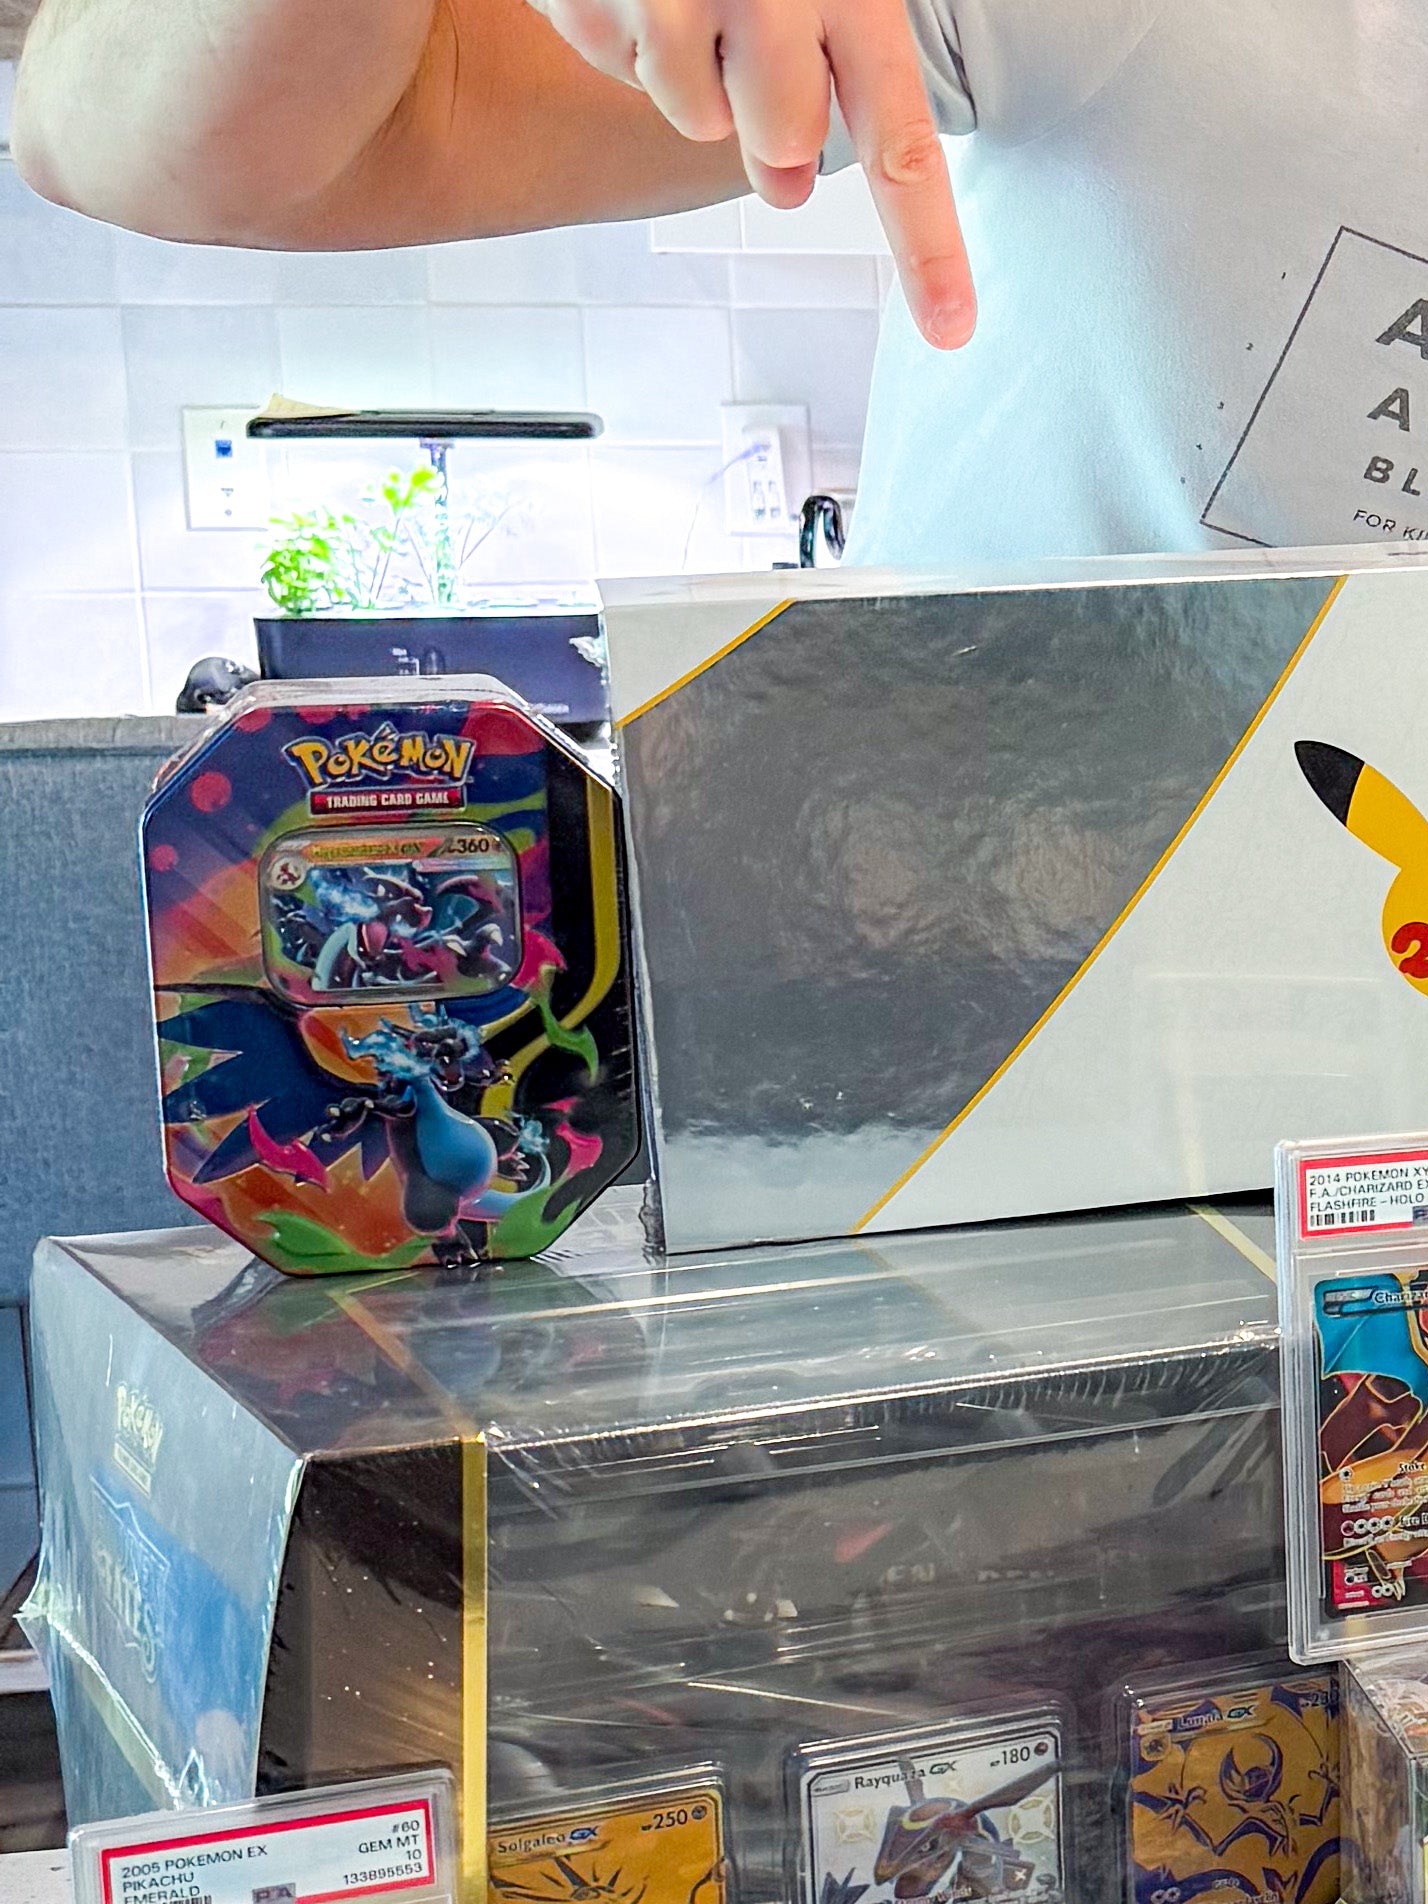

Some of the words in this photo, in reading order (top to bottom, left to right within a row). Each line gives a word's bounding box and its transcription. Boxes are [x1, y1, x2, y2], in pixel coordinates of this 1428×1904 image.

[1353, 509, 1396, 532] FOR
[326, 795, 377, 808] TRADING
[381, 795, 412, 807] CARD
[415, 793, 449, 805] GAME
[456, 838, 490, 854] 360
[1310, 1173, 1340, 1186] 2014
[1345, 1167, 1409, 1183] POKEMON
[1310, 1198, 1377, 1213] FLASHFIRE
[1390, 1192, 1425, 1206] HOLO
[122, 1862, 161, 1880] 2005
[165, 1848, 244, 1873] POKEMON
[247, 1844, 268, 1858] EX
[391, 1820, 420, 1834] #60
[405, 1849, 422, 1862] 10
[122, 1872, 195, 1893] PIKACHU
[358, 1840, 393, 1855] GEM
[396, 1834, 420, 1847] MT
